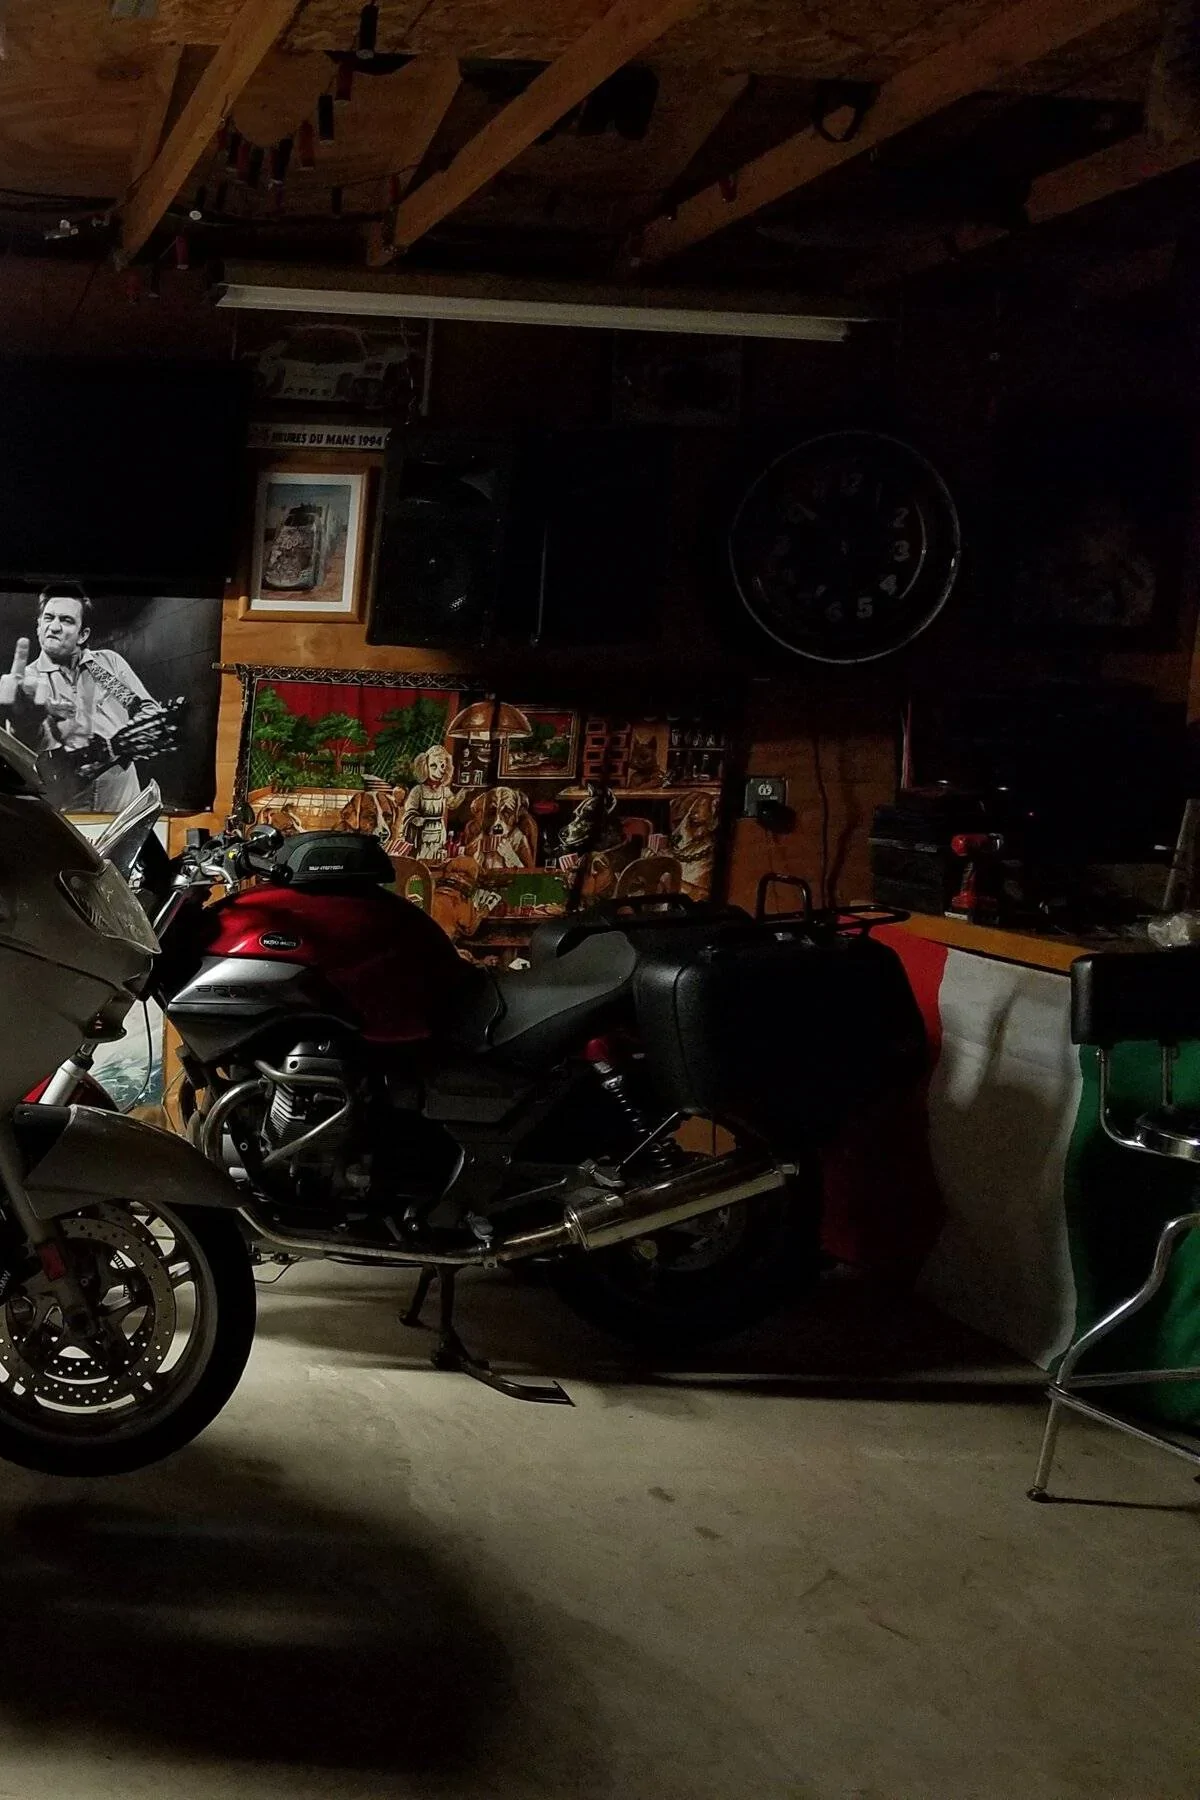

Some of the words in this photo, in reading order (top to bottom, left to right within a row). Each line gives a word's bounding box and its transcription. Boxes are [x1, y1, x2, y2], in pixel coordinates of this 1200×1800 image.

[308, 433, 324, 445] DU
[326, 434, 357, 446] MANS
[358, 435, 383, 447] 1994
[856, 596, 874, 621] 5
